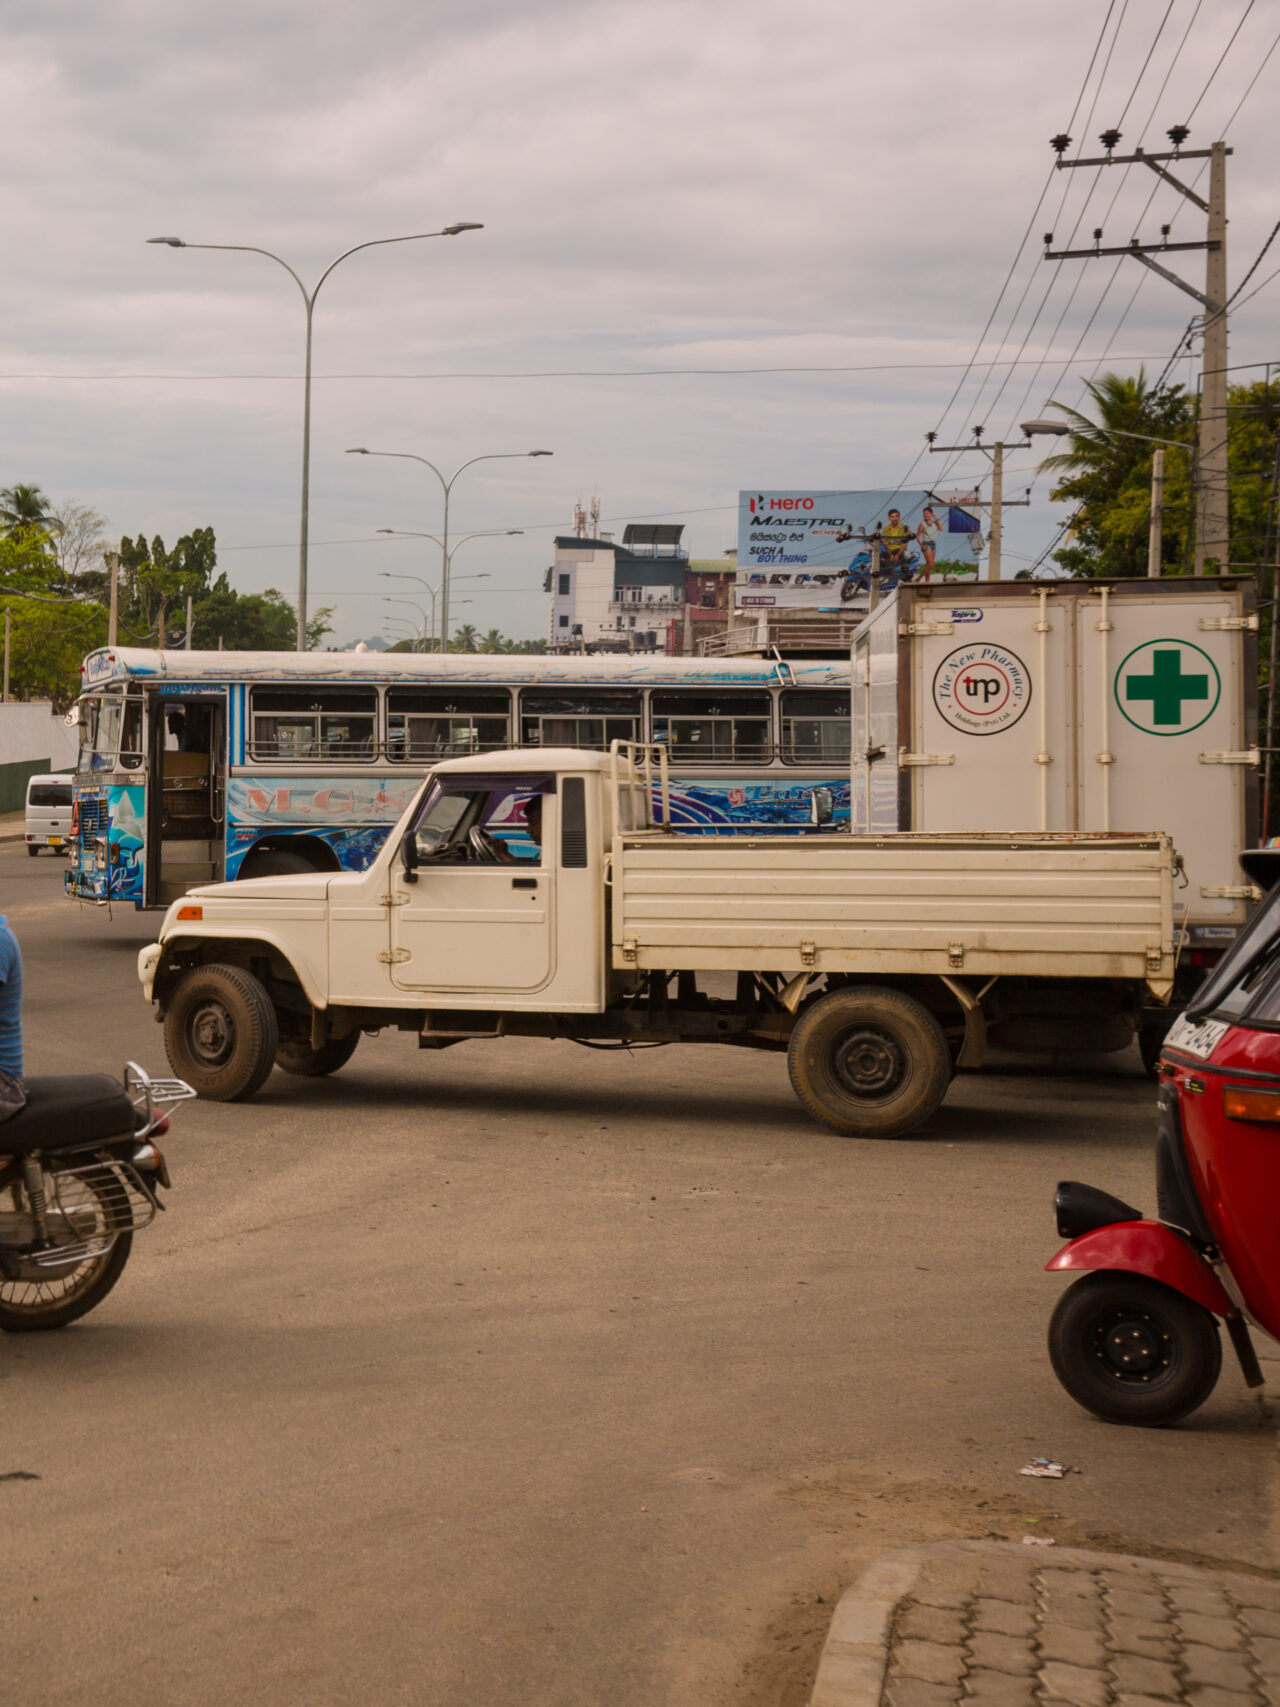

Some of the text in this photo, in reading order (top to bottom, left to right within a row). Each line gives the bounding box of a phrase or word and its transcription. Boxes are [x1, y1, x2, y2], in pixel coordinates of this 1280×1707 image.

[770, 497, 815, 510] Hero
[750, 516, 846, 529] MAESTRO
[749, 546, 784, 555] SUCH A
[757, 554, 808, 563] BOY THING
[938, 648, 1024, 700] The New Pharmacy
[954, 712, 982, 728] Holdings
